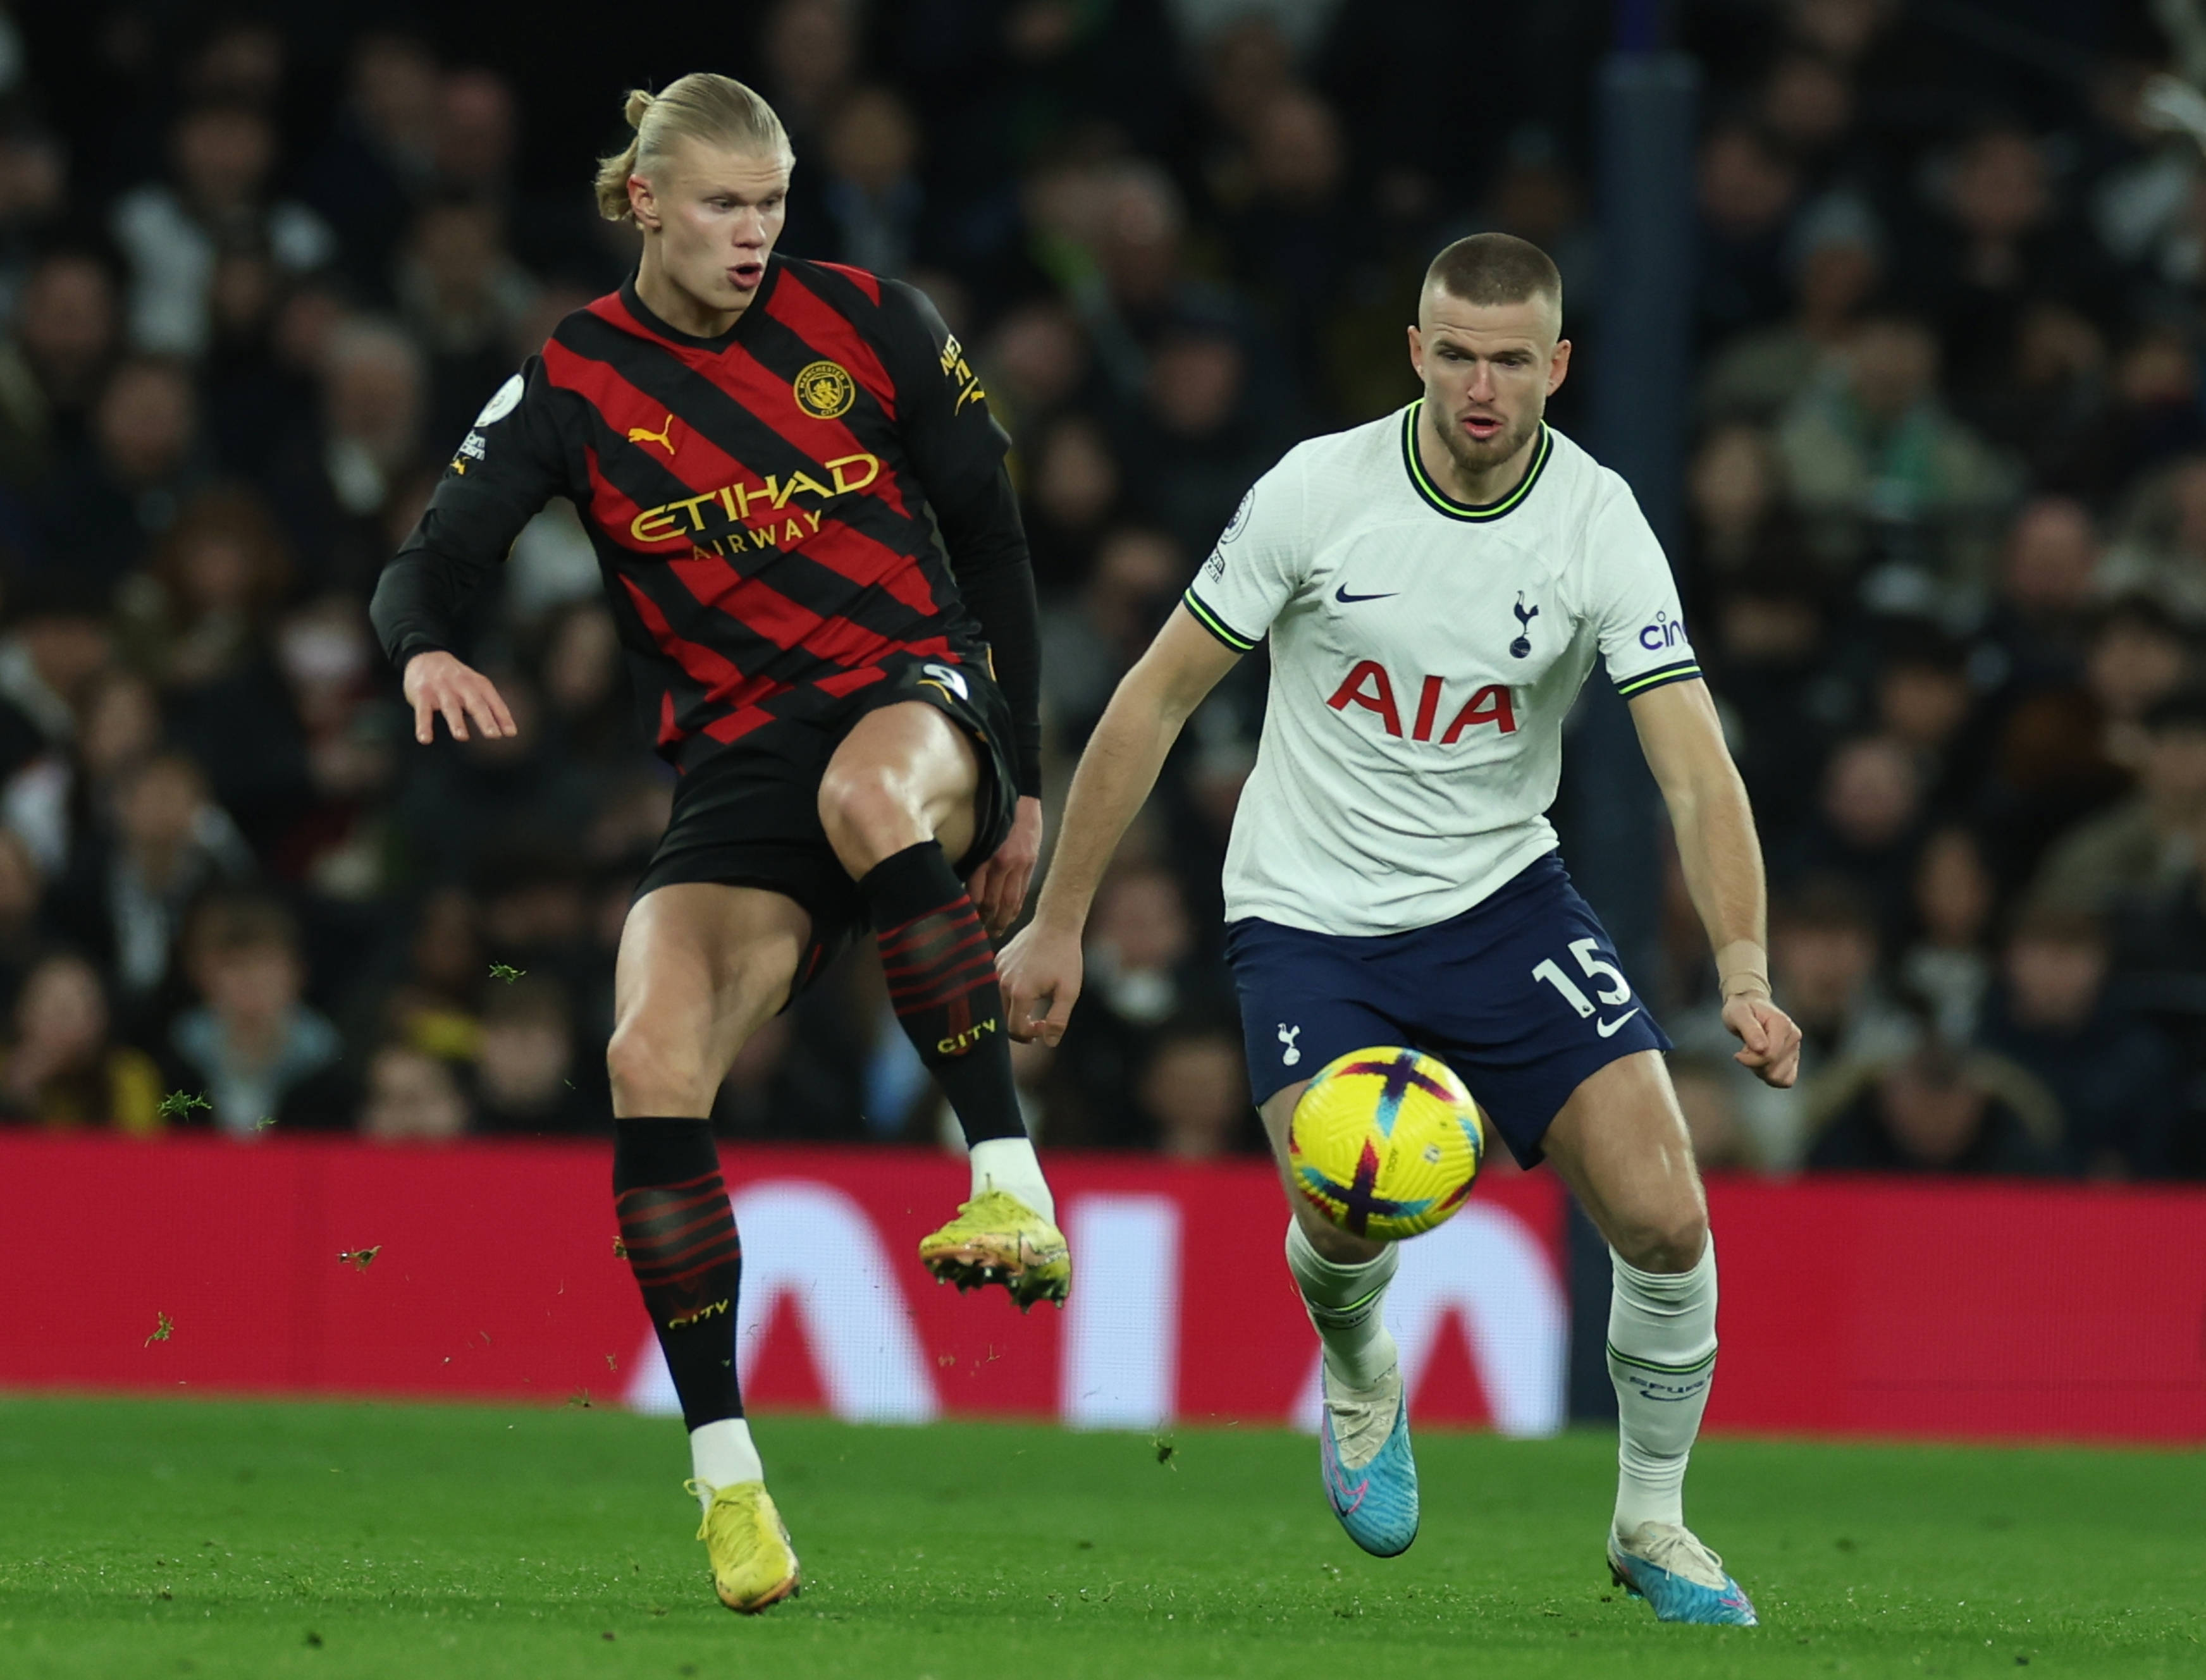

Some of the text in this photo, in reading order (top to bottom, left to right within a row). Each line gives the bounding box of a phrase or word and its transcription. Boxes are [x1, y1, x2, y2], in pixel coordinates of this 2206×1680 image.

[820, 408, 839, 416] CITY
[631, 453, 879, 542] ETIHAD
[1326, 660, 1516, 745] AIA
[1532, 938, 1631, 1018] 15
[937, 1017, 995, 1053] CITY
